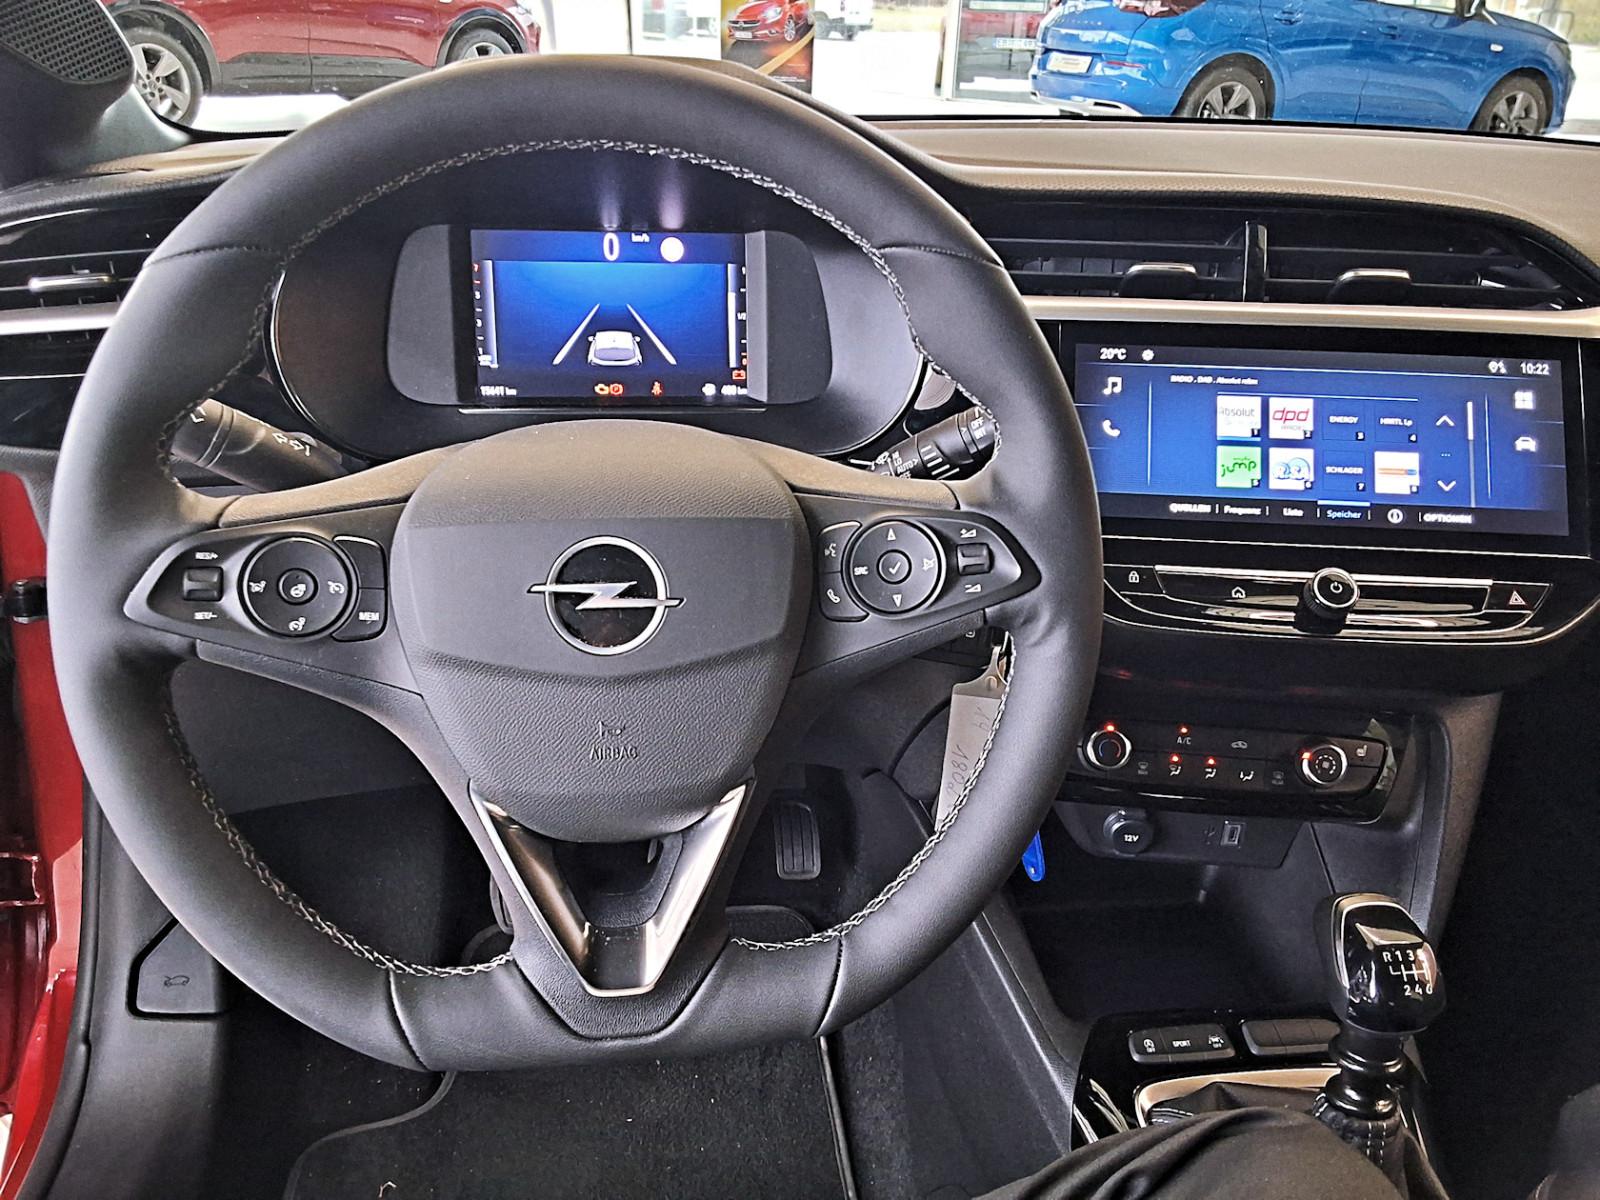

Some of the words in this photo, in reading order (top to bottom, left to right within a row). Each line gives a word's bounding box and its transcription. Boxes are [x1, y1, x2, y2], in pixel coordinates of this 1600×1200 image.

[603, 232, 619, 261] 0
[1520, 362, 1550, 375] 10:22
[1326, 509, 1362, 519] Speicher
[1176, 736, 1192, 745] A/C
[590, 744, 638, 761] AIRBAG
[1123, 833, 1139, 842] 12V
[1382, 951, 1393, 963] R
[1394, 950, 1403, 962] 1
[1406, 949, 1415, 961] 3
[1403, 984, 1412, 996] 2
[1415, 983, 1423, 995] 4
